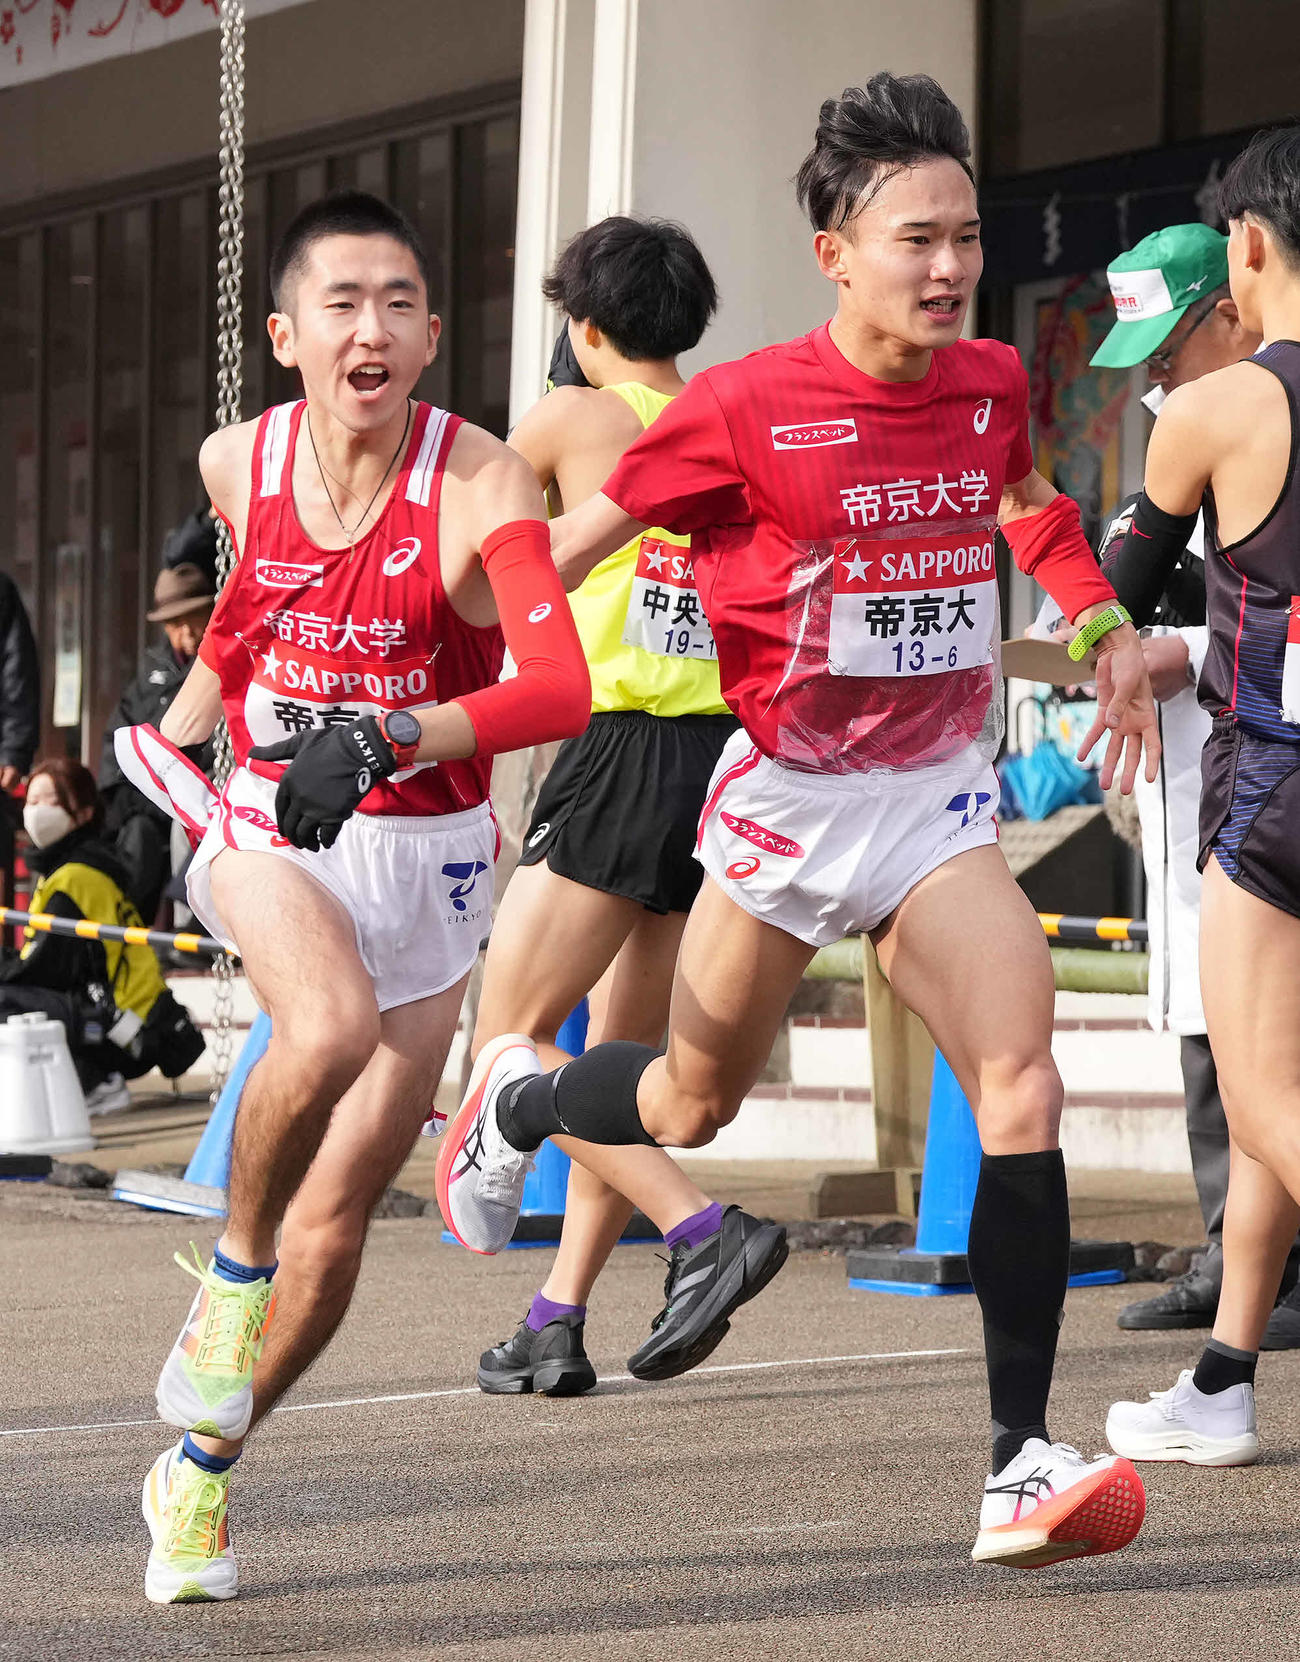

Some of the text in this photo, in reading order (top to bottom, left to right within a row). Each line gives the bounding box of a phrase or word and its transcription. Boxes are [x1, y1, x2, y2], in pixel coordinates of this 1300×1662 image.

[784, 427, 846, 442] フランスベッド
[840, 469, 990, 527] 帝京大学
[670, 555, 695, 580] SA
[880, 542, 992, 582] SAPPORO
[642, 585, 711, 628] 中央
[864, 589, 976, 639] 帝京大
[263, 609, 407, 657] 帝京大学
[892, 641, 957, 672] 13-6
[283, 659, 427, 700] SAPPORO
[272, 701, 385, 733] 帝京
[353, 730, 383, 773] EIKYO
[728, 818, 797, 854] フランスベッド
[443, 909, 482, 925] EIKYO
